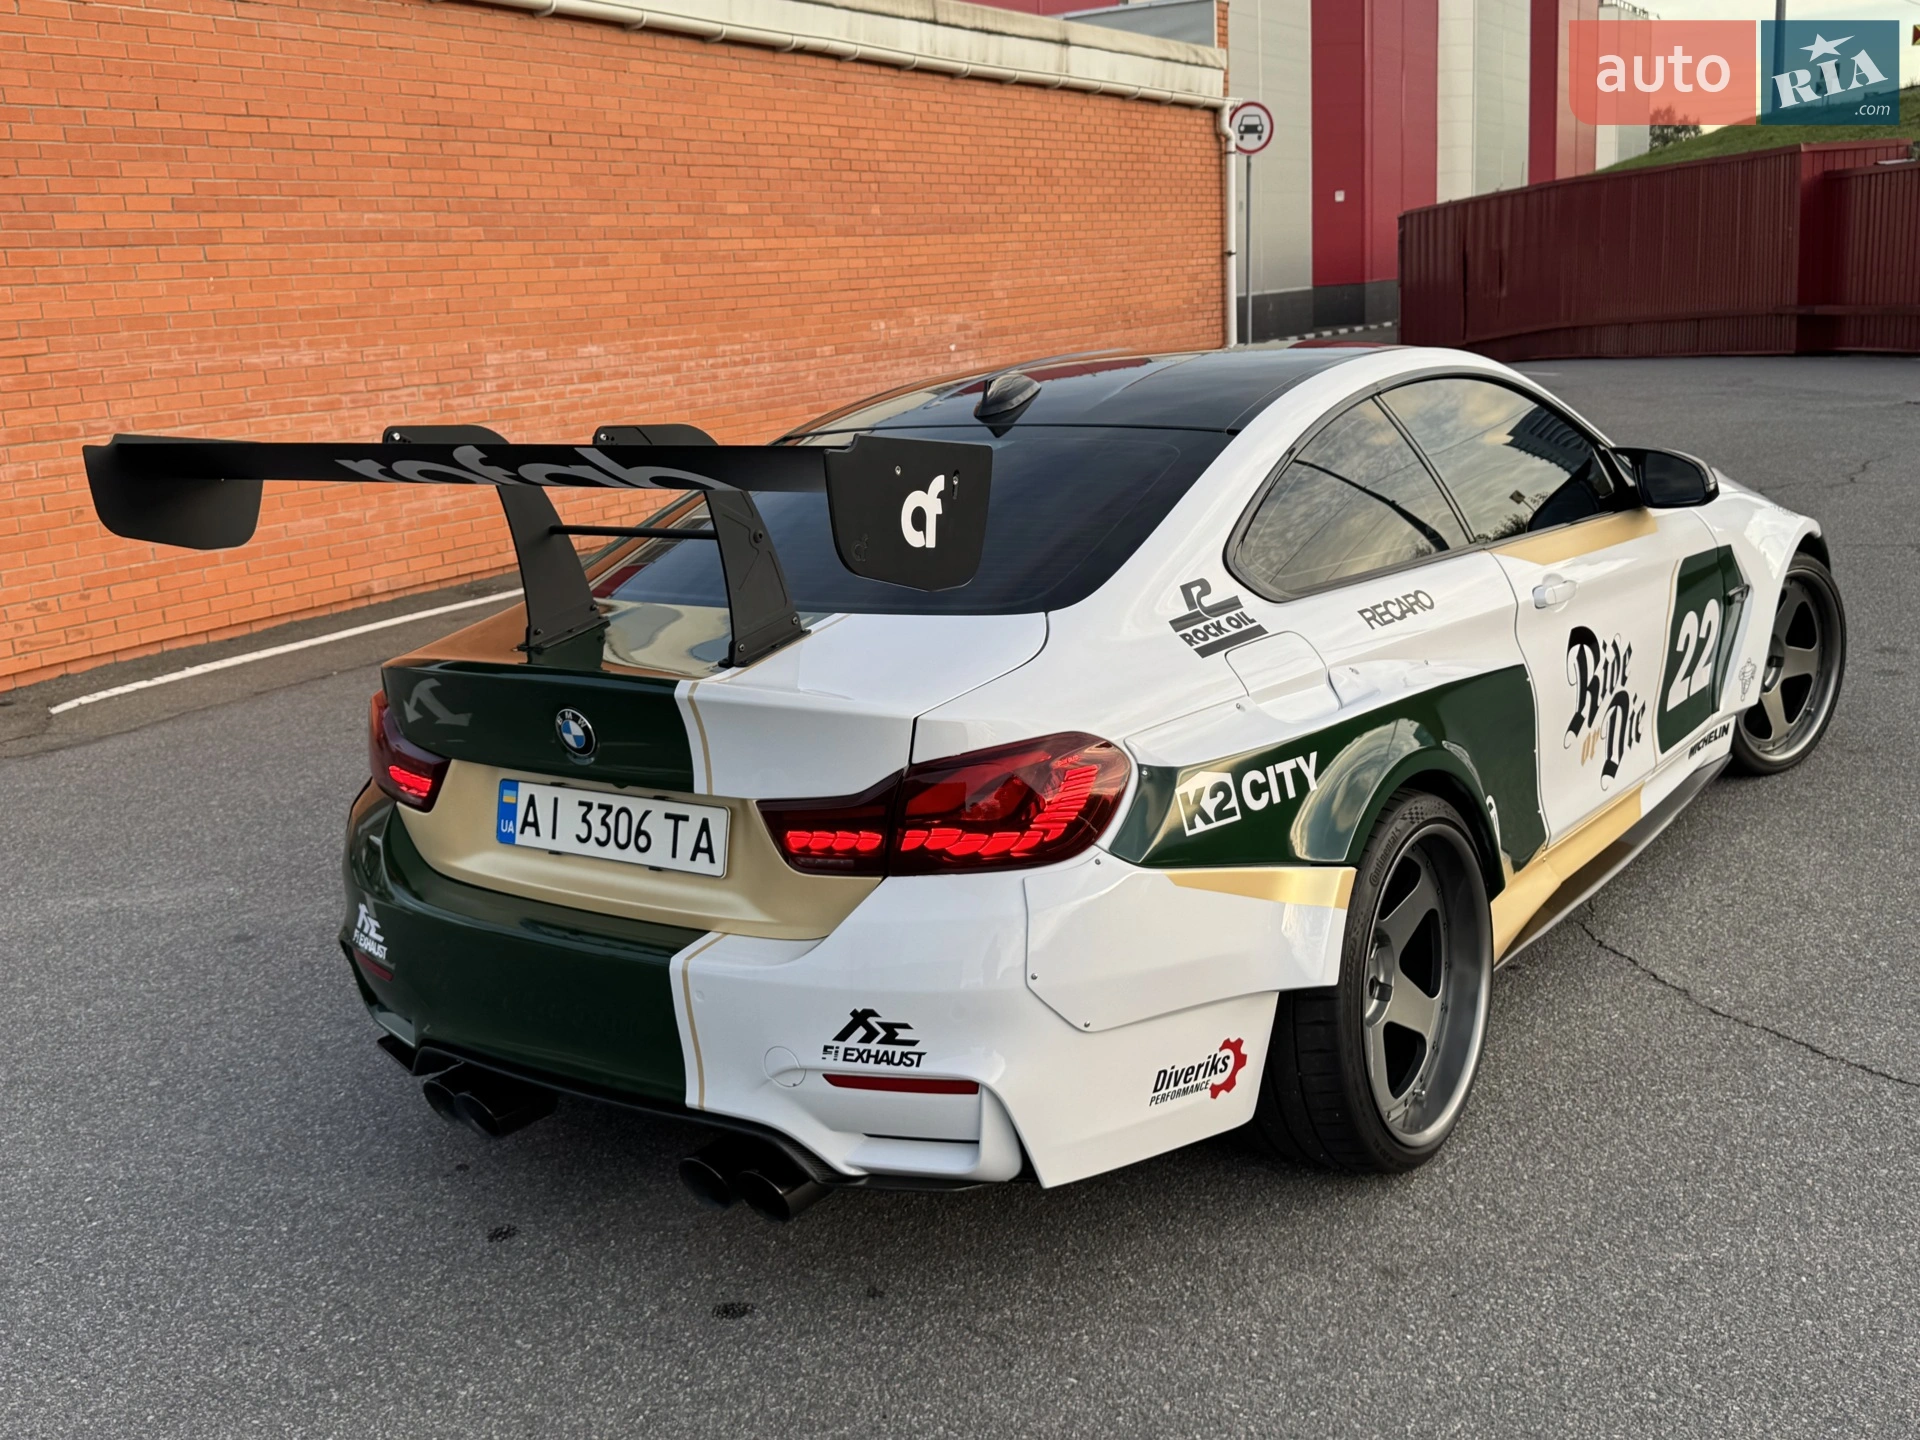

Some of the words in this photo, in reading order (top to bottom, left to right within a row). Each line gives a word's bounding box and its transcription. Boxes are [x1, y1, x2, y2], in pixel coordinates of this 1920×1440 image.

[1179, 620, 1231, 647] ROCK
[1226, 611, 1257, 629] OIL
[1357, 590, 1435, 630] RECARO
[1667, 599, 1720, 712] 22
[1564, 626, 1633, 749] Ride
[557, 711, 587, 728] BMW
[1600, 690, 1646, 791] Die
[1688, 723, 1730, 759] MICHELIN
[1179, 781, 1238, 831] K2
[1242, 751, 1318, 811] CITY
[501, 819, 515, 834] UA
[519, 794, 559, 840] AI
[575, 800, 653, 853] 3306
[664, 812, 716, 864] TA
[842, 1047, 928, 1068] EXHAUST
[1152, 1053, 1231, 1094] Diveriks
[1149, 1079, 1211, 1107] PERFORMANCE
